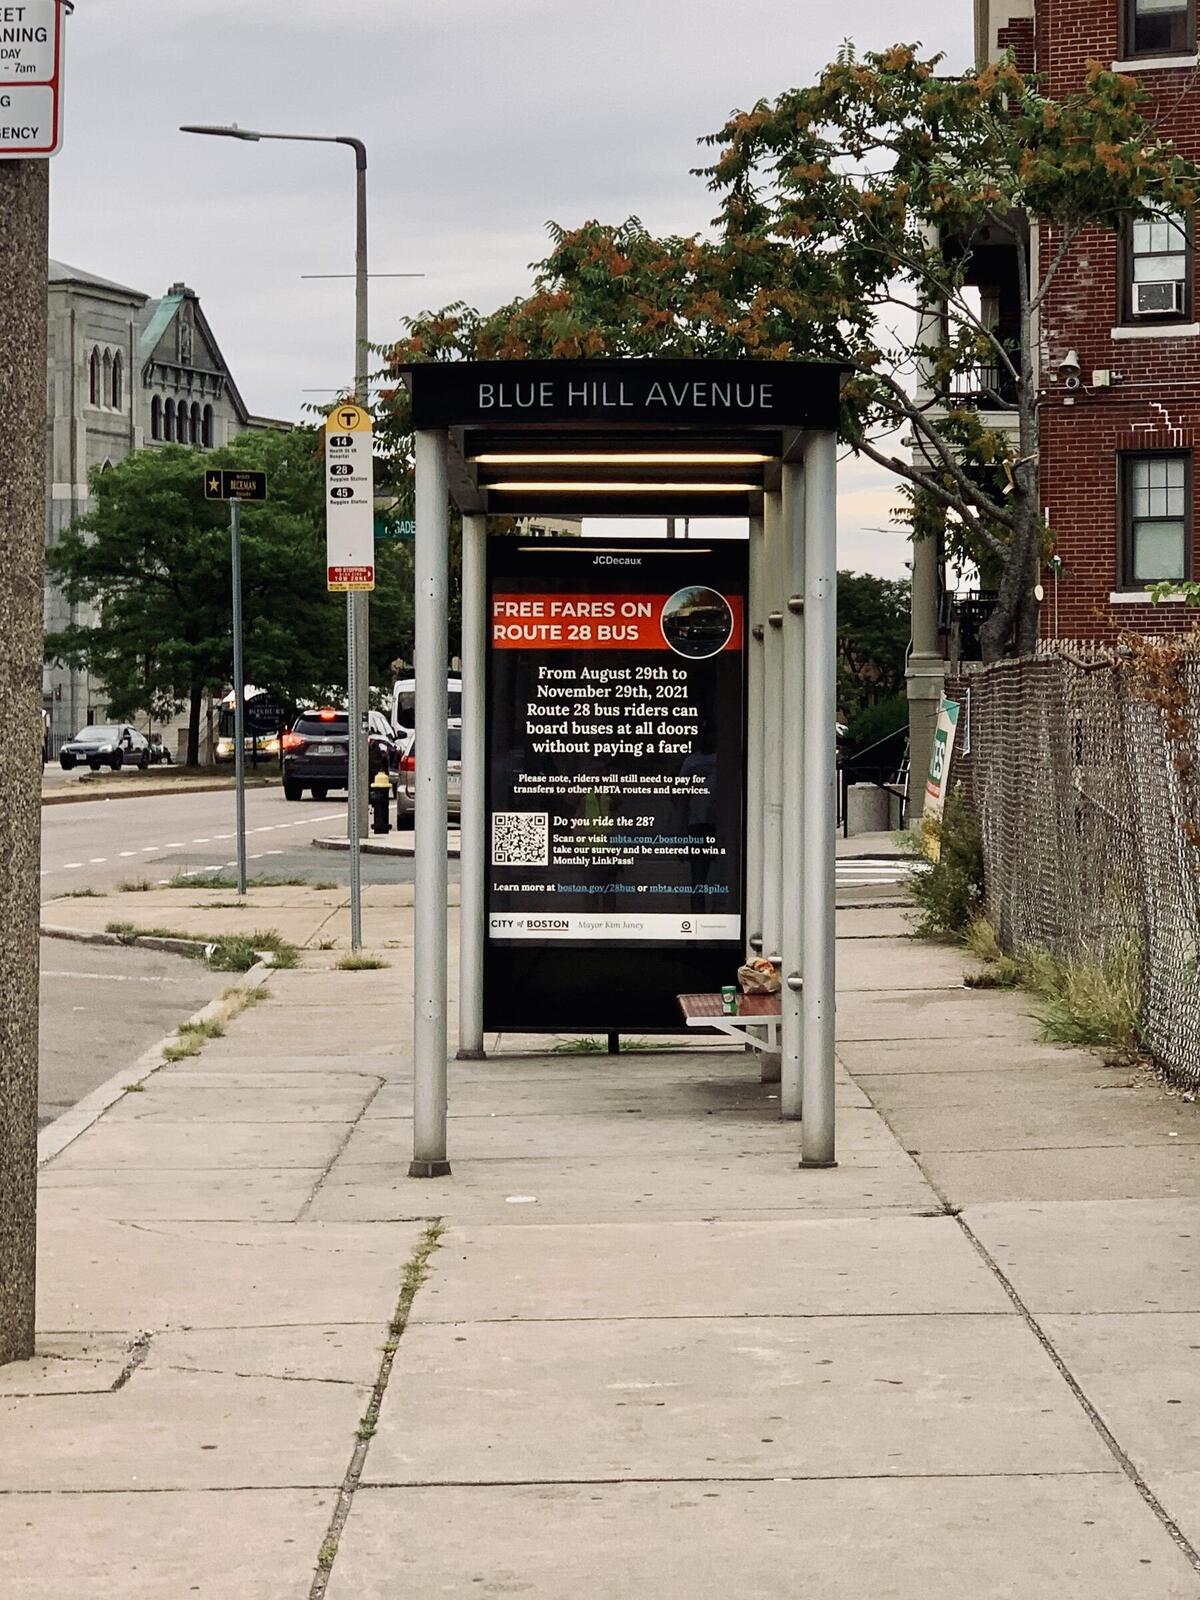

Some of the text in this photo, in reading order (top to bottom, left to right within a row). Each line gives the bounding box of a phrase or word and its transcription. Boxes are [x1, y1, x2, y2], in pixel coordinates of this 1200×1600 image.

[0, 26, 47, 43] NING
[14, 62, 36, 73] 7am
[0, 127, 39, 140] ENCY
[479, 382, 773, 408] BLUE HILL AVENUE
[341, 412, 356, 426] T
[336, 437, 348, 446] 14
[335, 465, 348, 475] 28
[336, 488, 348, 498] 45
[592, 555, 642, 565] JCDecaux
[493, 602, 652, 618] FREE FARES ON
[493, 625, 639, 640] ROUTE 28 BUS
[538, 666, 688, 684] From August 29th to
[536, 685, 689, 701] November 29th, 2021
[526, 703, 699, 717] Route 28 bus riders can
[526, 721, 699, 735] board buses at all doors
[532, 739, 693, 757] without paying a fare!
[518, 773, 706, 786] Please note, riders will still need to pay for
[513, 785, 710, 795] transfers to other MBTA routes and services.
[553, 815, 655, 829] Do you ride the 28?
[553, 834, 716, 845] Scan or visit mbta.com/bostonbus to
[553, 845, 572, 854] take
[591, 847, 621, 856] survey
[623, 845, 640, 854] and
[641, 845, 653, 854] be
[654, 845, 689, 854] entered
[690, 846, 701, 854] to
[702, 845, 719, 854] win
[720, 847, 726, 855] a
[553, 856, 634, 867] Monthly LinkPass!
[493, 883, 520, 891] Learn
[521, 884, 545, 892] more
[546, 884, 556, 892] at
[557, 884, 635, 894] boston.gov/28bus
[650, 884, 729, 895] mbta.com/28pilot
[490, 919, 514, 928] CITY
[516, 920, 525, 928] of
[526, 919, 569, 928] BOSTON
[578, 920, 603, 931] Mayor
